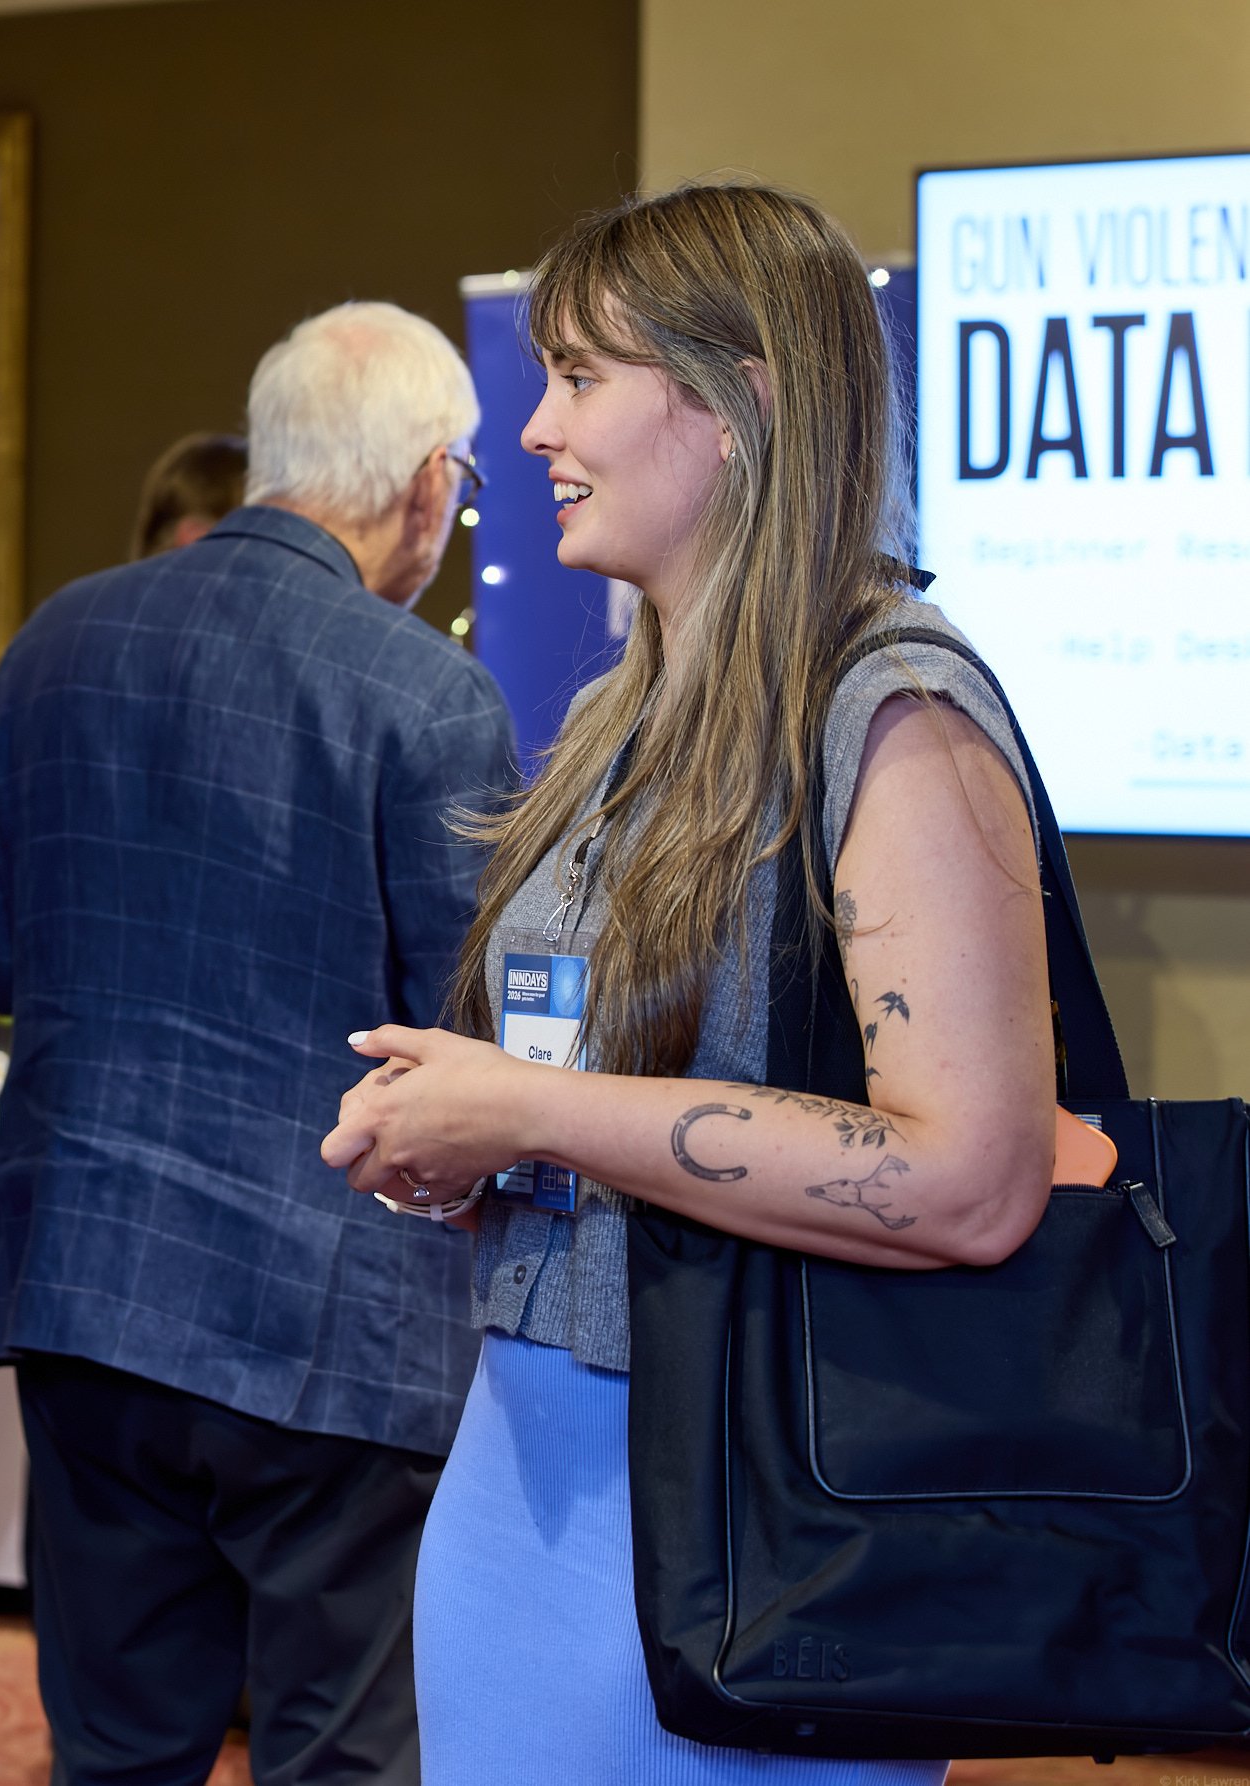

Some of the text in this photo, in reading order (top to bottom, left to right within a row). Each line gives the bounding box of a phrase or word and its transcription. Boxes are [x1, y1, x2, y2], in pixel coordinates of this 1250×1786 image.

[952, 210, 1049, 293] GUN
[958, 311, 1215, 480] DATA
[509, 971, 548, 988] INNDAYS
[507, 990, 522, 1001] 2026
[528, 1045, 552, 1061] Clare
